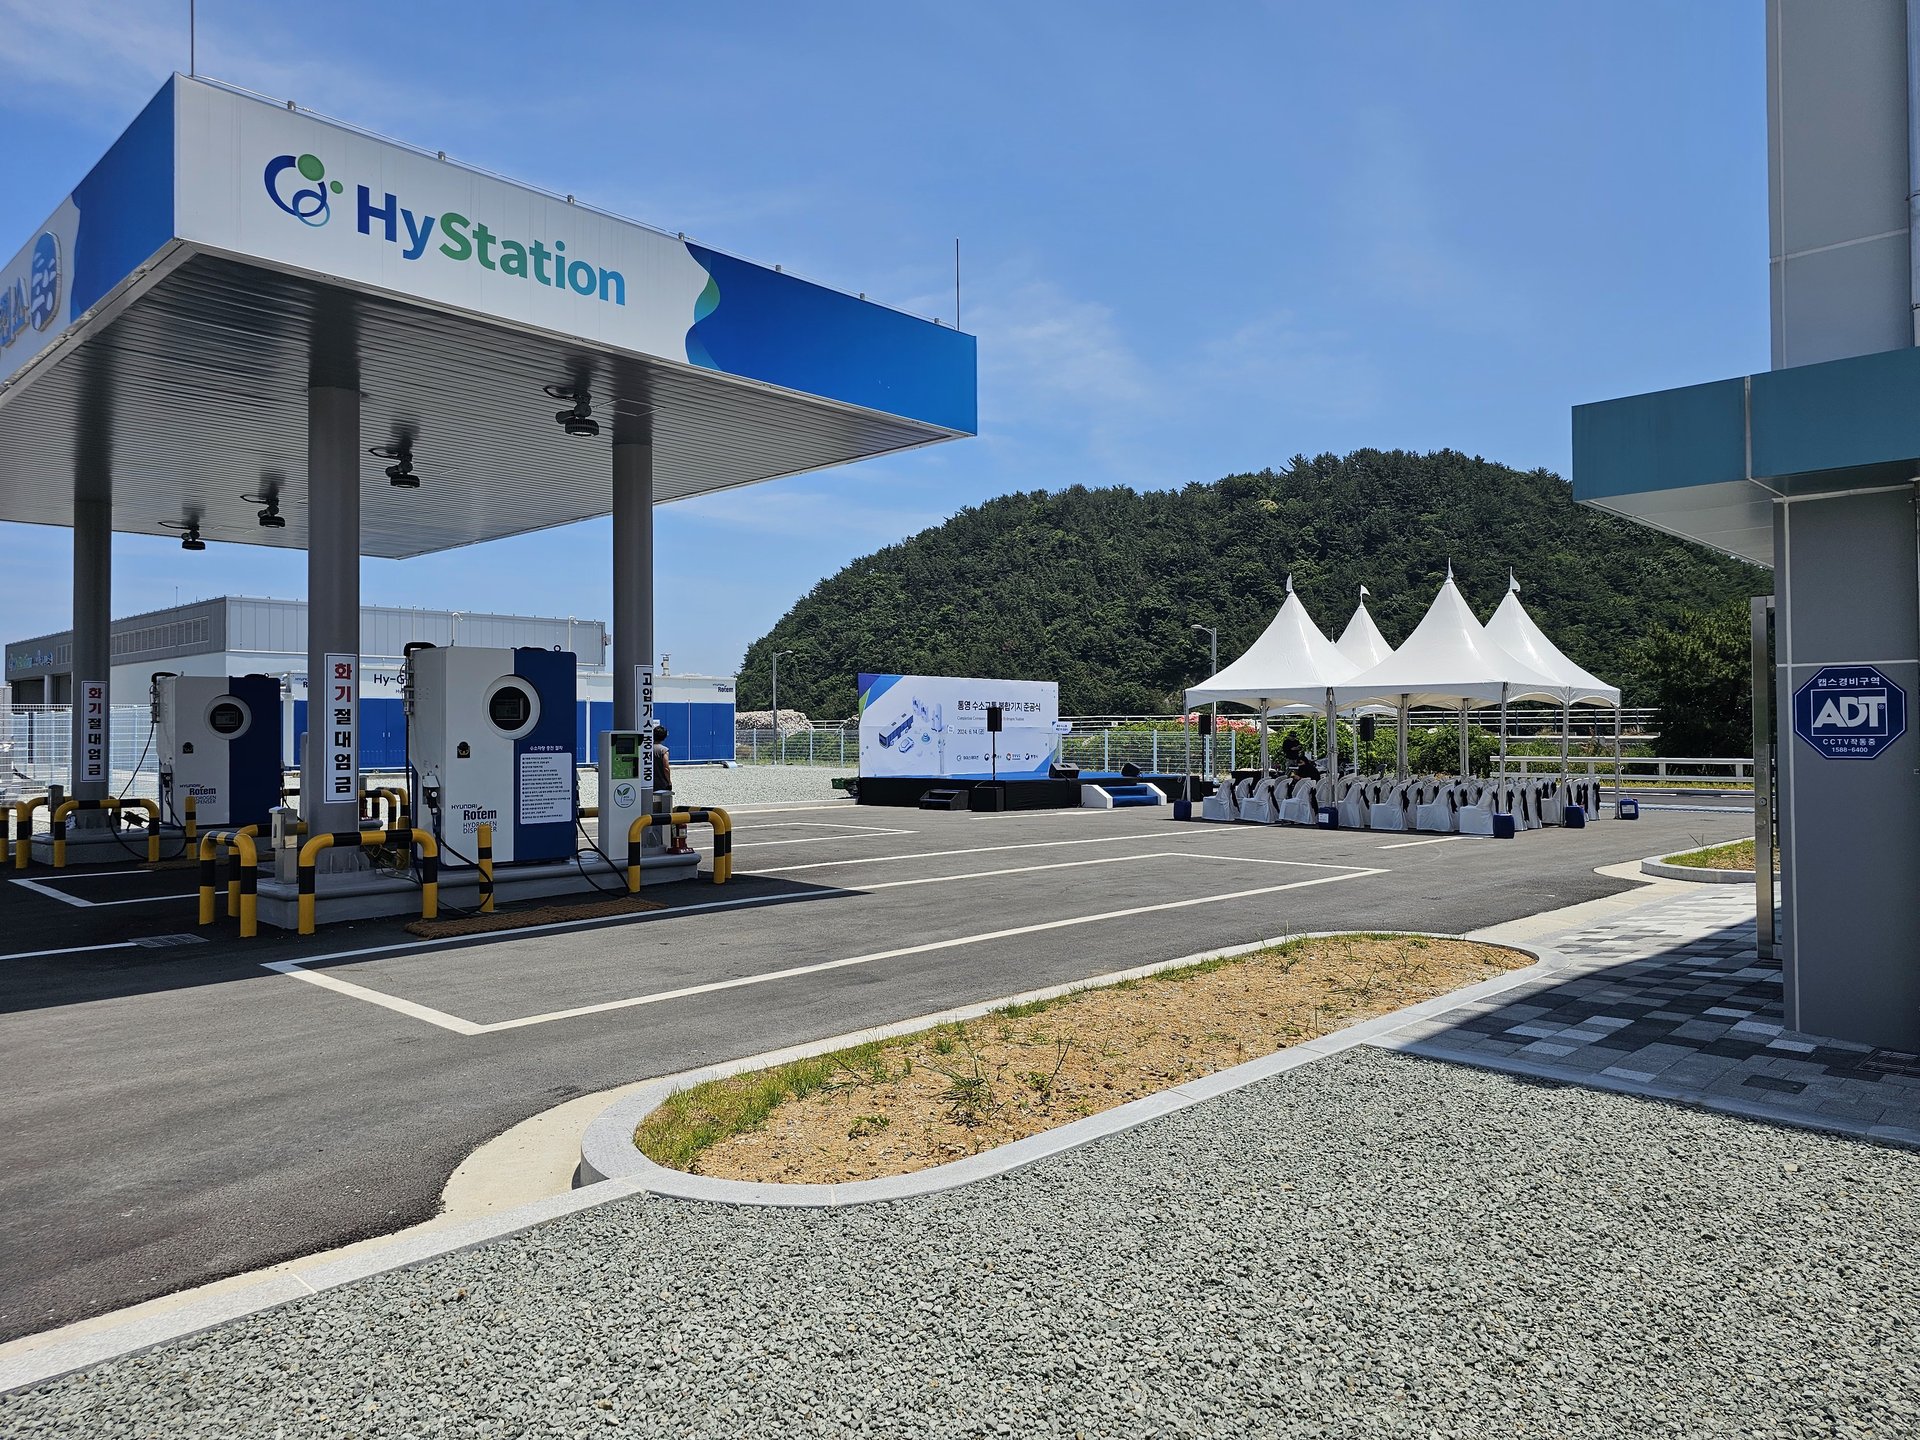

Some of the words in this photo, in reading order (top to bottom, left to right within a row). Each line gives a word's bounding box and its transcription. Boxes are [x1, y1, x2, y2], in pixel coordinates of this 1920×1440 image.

[357, 184, 626, 306] HyStation
[374, 674, 405, 687] Hy-G
[1817, 677, 1880, 687] 캡스경비구역
[957, 700, 971, 711] 통영
[1023, 702, 1041, 712] 준공식
[1813, 696, 1886, 728] ADT
[88, 687, 102, 776] 화기절대엄금
[334, 663, 352, 794] 화기절대엄금
[642, 672, 653, 781] 고압가스충전중
[189, 785, 216, 795] Rotem
[463, 806, 497, 820] Rotem
